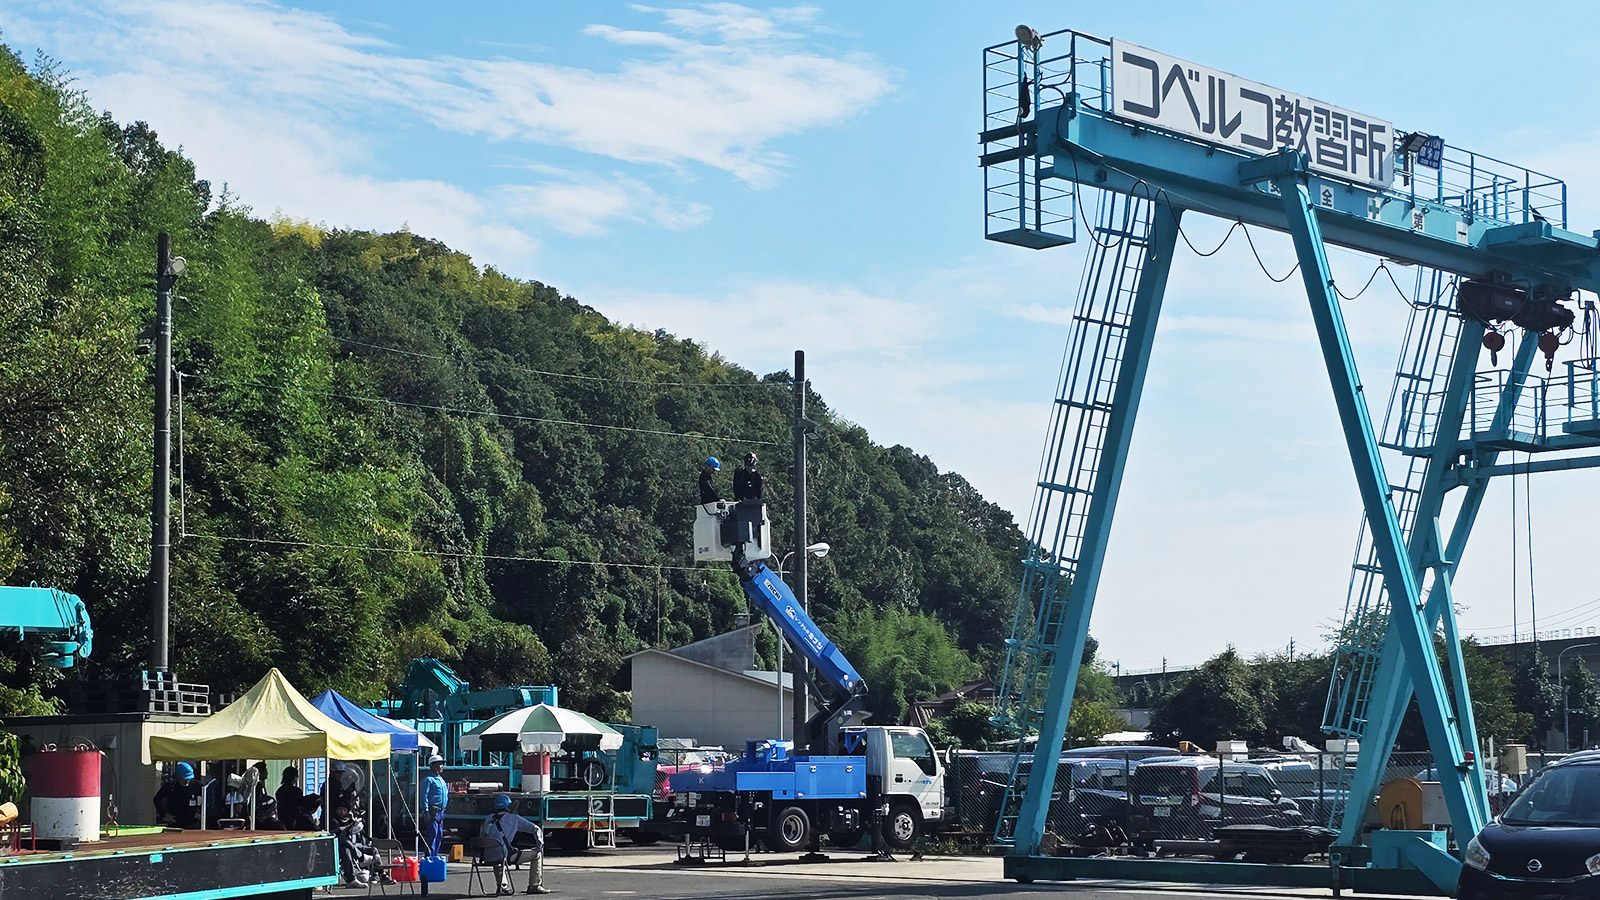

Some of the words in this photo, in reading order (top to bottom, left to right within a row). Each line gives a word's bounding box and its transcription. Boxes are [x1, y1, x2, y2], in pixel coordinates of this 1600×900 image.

[1122, 50, 1386, 182] コベルコ教習所
[593, 800, 604, 814] 2
